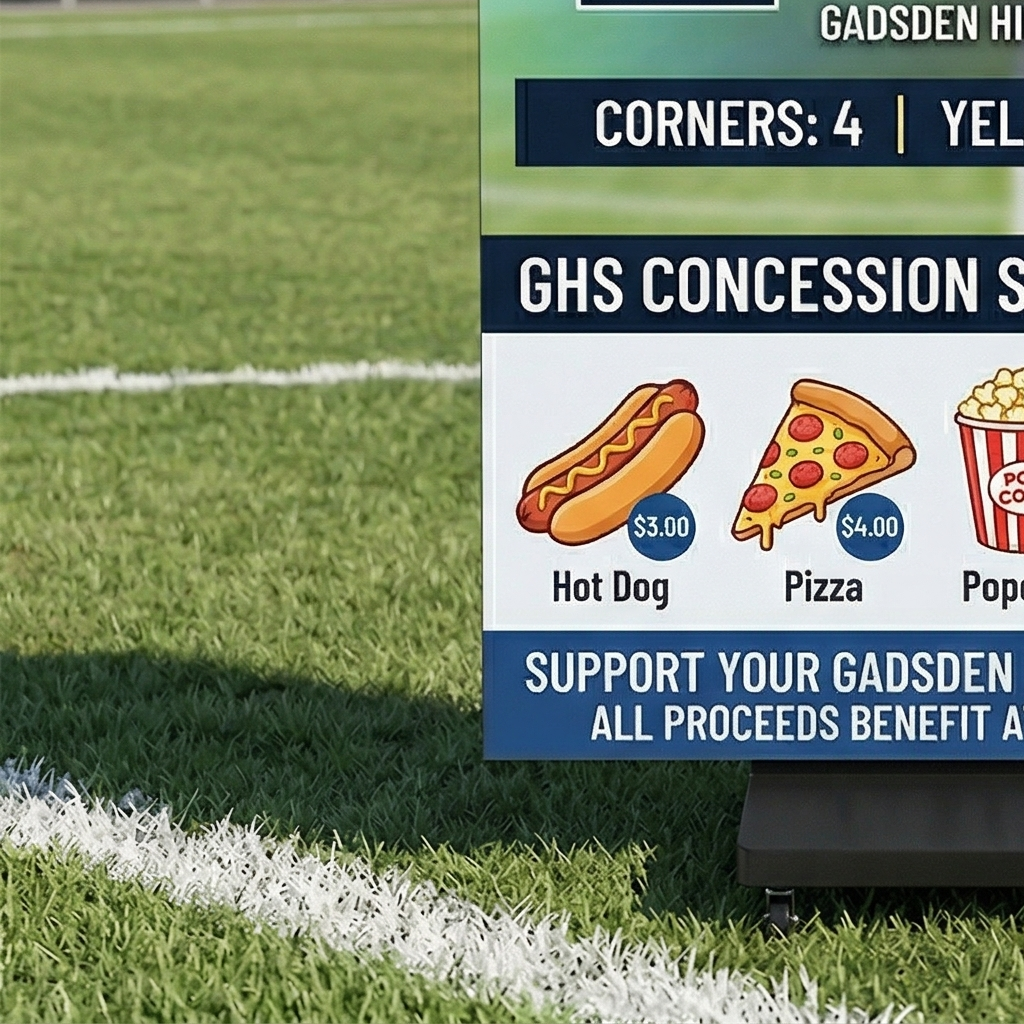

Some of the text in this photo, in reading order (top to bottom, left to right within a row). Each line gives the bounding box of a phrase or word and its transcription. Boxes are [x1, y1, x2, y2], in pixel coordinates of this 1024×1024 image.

[821, 4, 977, 41] GADSDEN
[596, 99, 863, 147] CORNERS: 4
[520, 257, 623, 313] GHS
[643, 257, 977, 313] CONCESSION
[634, 514, 689, 540] $3.00
[842, 514, 897, 540] $4.00
[553, 570, 669, 611] Hot Dog
[785, 569, 863, 602] Pizza
[526, 651, 705, 693] SUPPORT
[718, 652, 820, 693] YOUR
[833, 651, 1012, 693] GADSDEN
[591, 705, 653, 741] ALL
[665, 705, 839, 741] PROCEEDS
[851, 705, 991, 741] BENEFIT
